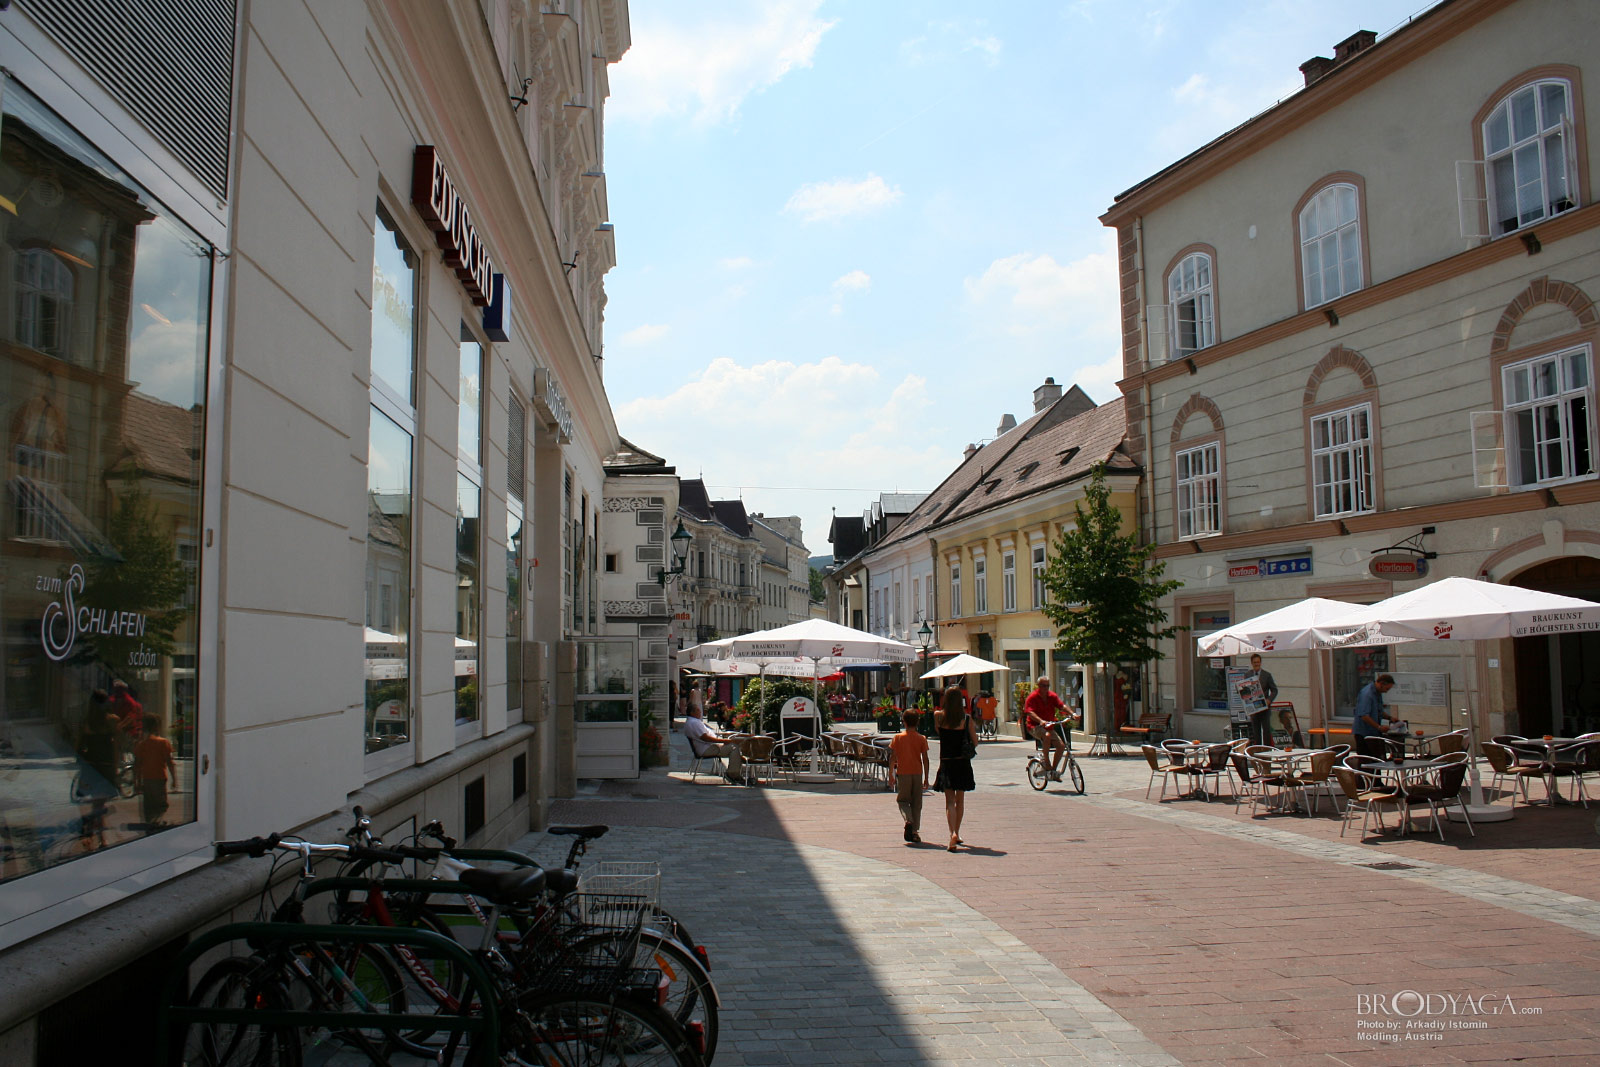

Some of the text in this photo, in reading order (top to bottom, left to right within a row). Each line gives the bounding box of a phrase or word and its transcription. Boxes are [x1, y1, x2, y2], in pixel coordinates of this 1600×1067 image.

[430, 148, 494, 308] EDUSCHO
[1230, 561, 1308, 577] Hartlauer Foto
[1378, 562, 1413, 572] Hartlauer
[35, 574, 62, 593] zum
[41, 563, 146, 661] SCHLAFEN
[674, 612, 691, 621] nda
[1532, 611, 1583, 623] BRAUKUNST
[1329, 628, 1358, 636] BRAUKUN
[1516, 622, 1600, 635] AUF HÖCHSTER STUF
[128, 643, 157, 667] schön
